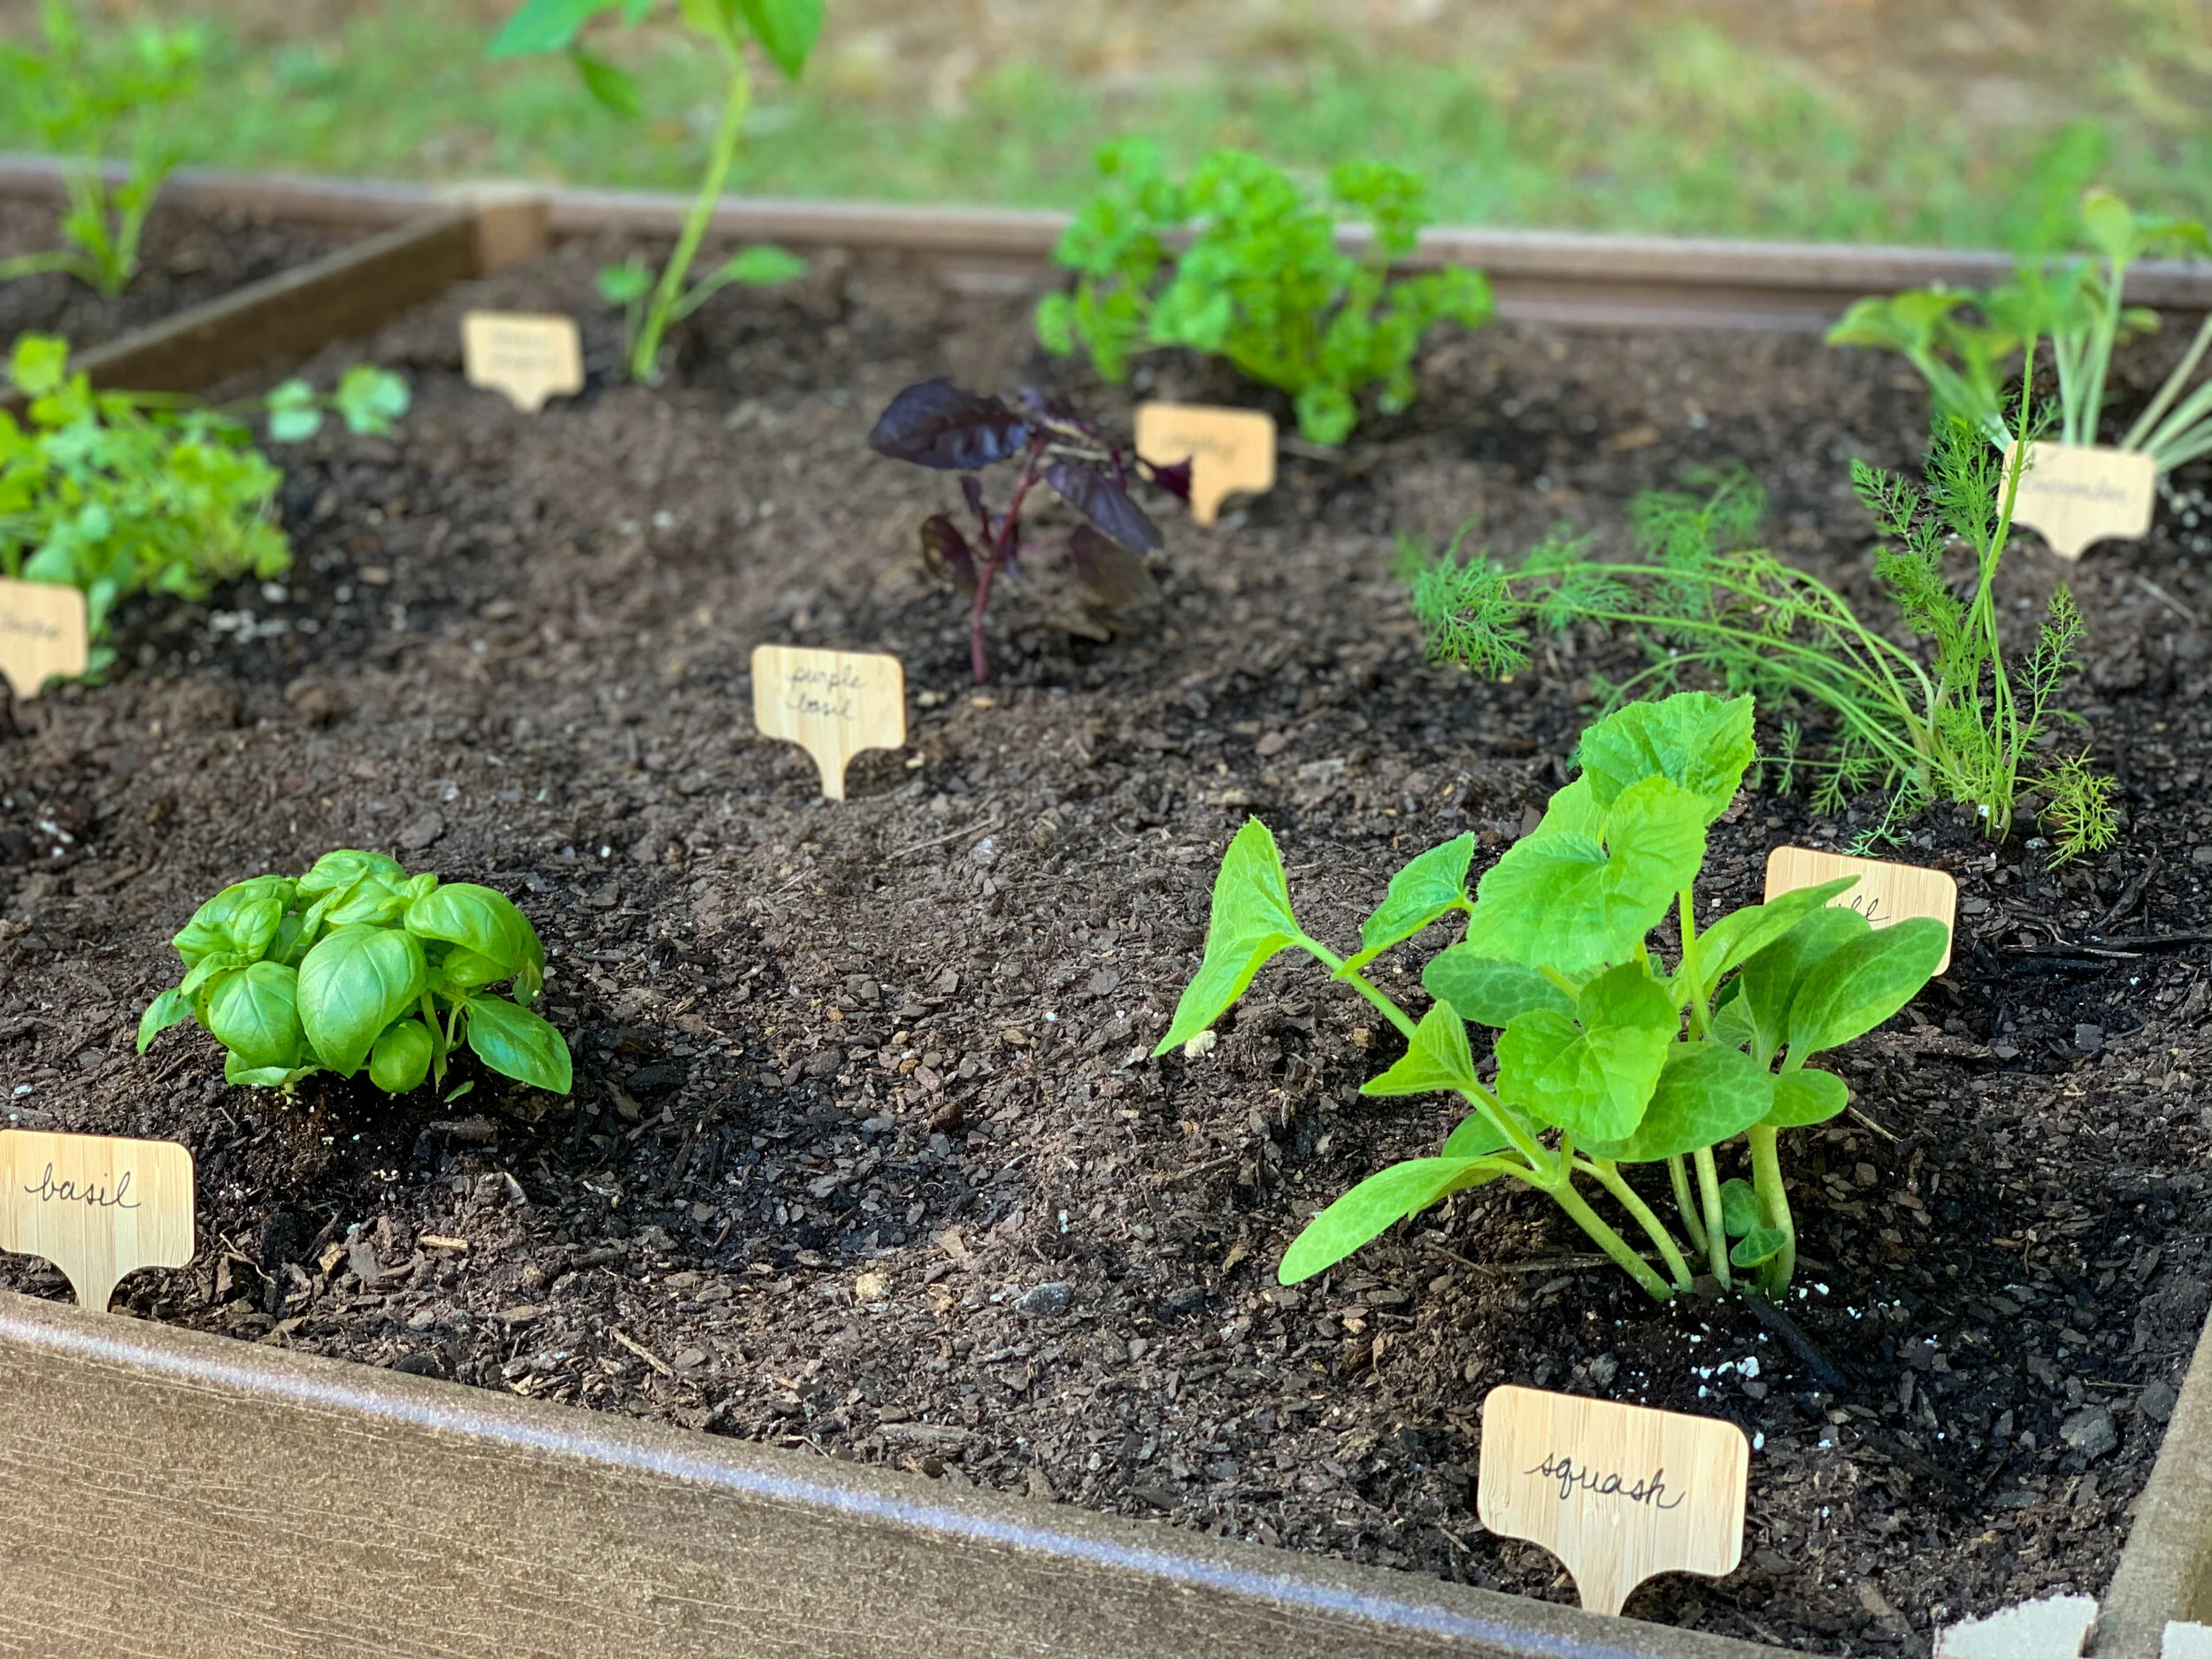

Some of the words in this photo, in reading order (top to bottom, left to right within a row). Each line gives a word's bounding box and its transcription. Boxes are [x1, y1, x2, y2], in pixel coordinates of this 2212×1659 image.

[787, 664, 868, 693] purple
[24, 1161, 142, 1209] basil
[1523, 1451, 1686, 1509] squash
